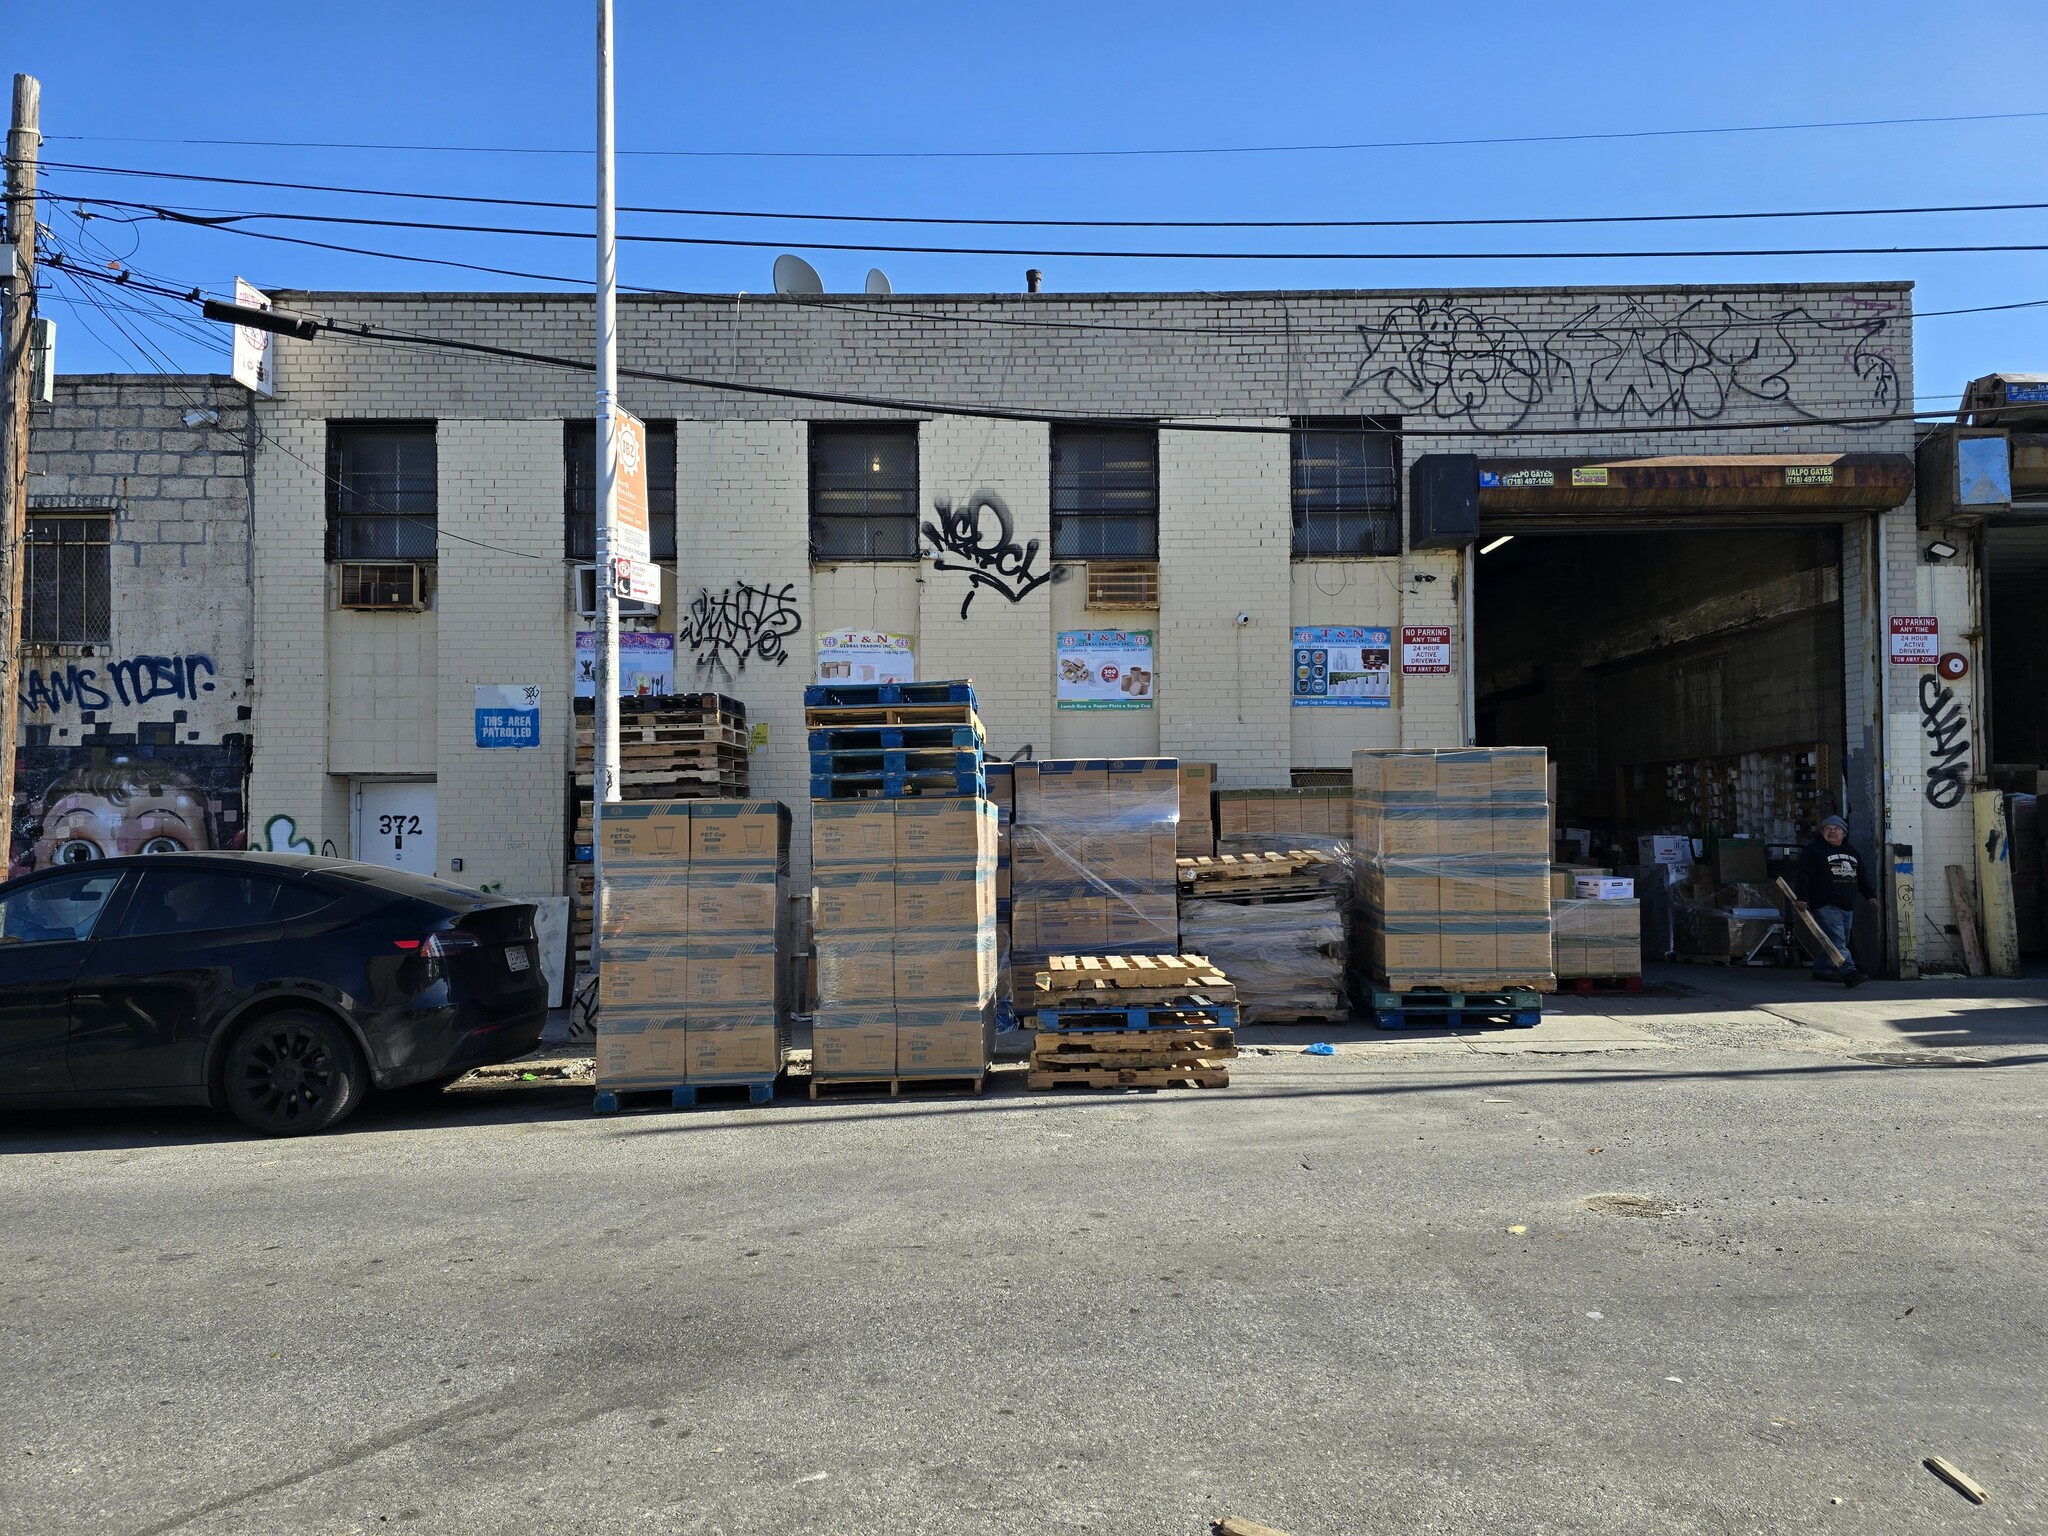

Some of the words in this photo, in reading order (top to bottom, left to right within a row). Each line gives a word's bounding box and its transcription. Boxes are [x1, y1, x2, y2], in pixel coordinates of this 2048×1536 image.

[623, 441, 634, 457] IBZ
[1509, 470, 1529, 478] ALPO
[1084, 633, 1095, 641] T
[1116, 633, 1126, 641] N
[1321, 629, 1332, 638] T
[1353, 629, 1364, 637] N
[636, 635, 647, 643] N
[845, 634, 856, 643] T
[877, 635, 888, 643] N
[483, 716, 503, 727] THIS
[508, 716, 531, 727] AREA
[483, 727, 531, 738] PATROLLED
[379, 815, 422, 835] 372
